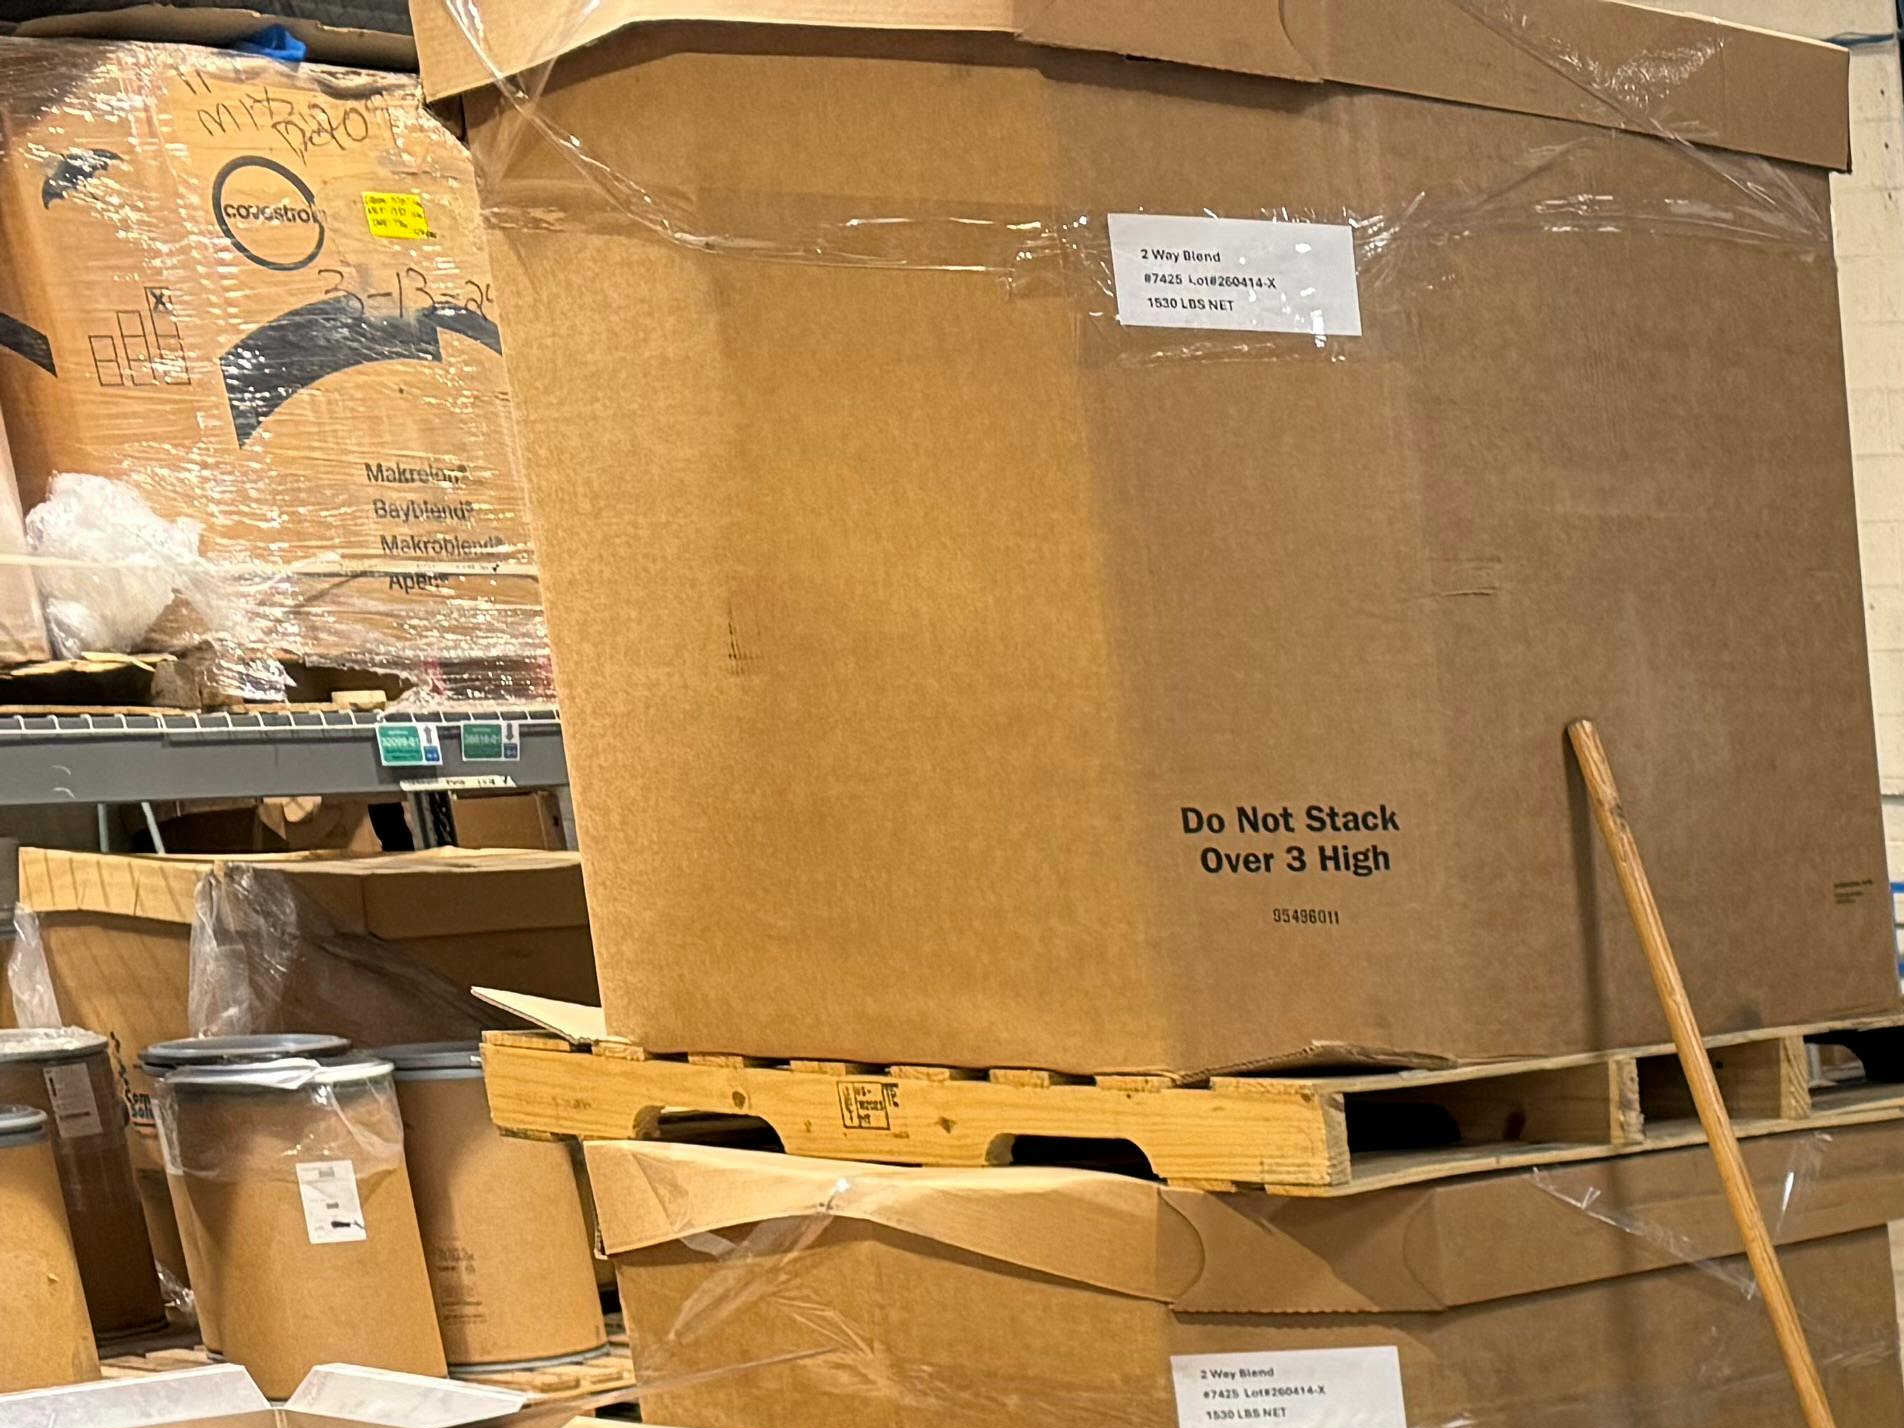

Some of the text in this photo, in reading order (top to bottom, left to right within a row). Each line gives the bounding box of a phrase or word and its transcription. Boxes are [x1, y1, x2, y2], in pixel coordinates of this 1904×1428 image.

[1140, 249, 1149, 260] 2
[1209, 299, 1234, 311] NET
[1181, 804, 1400, 834] Do Not Stack
[1200, 844, 1391, 877] Over 3 High
